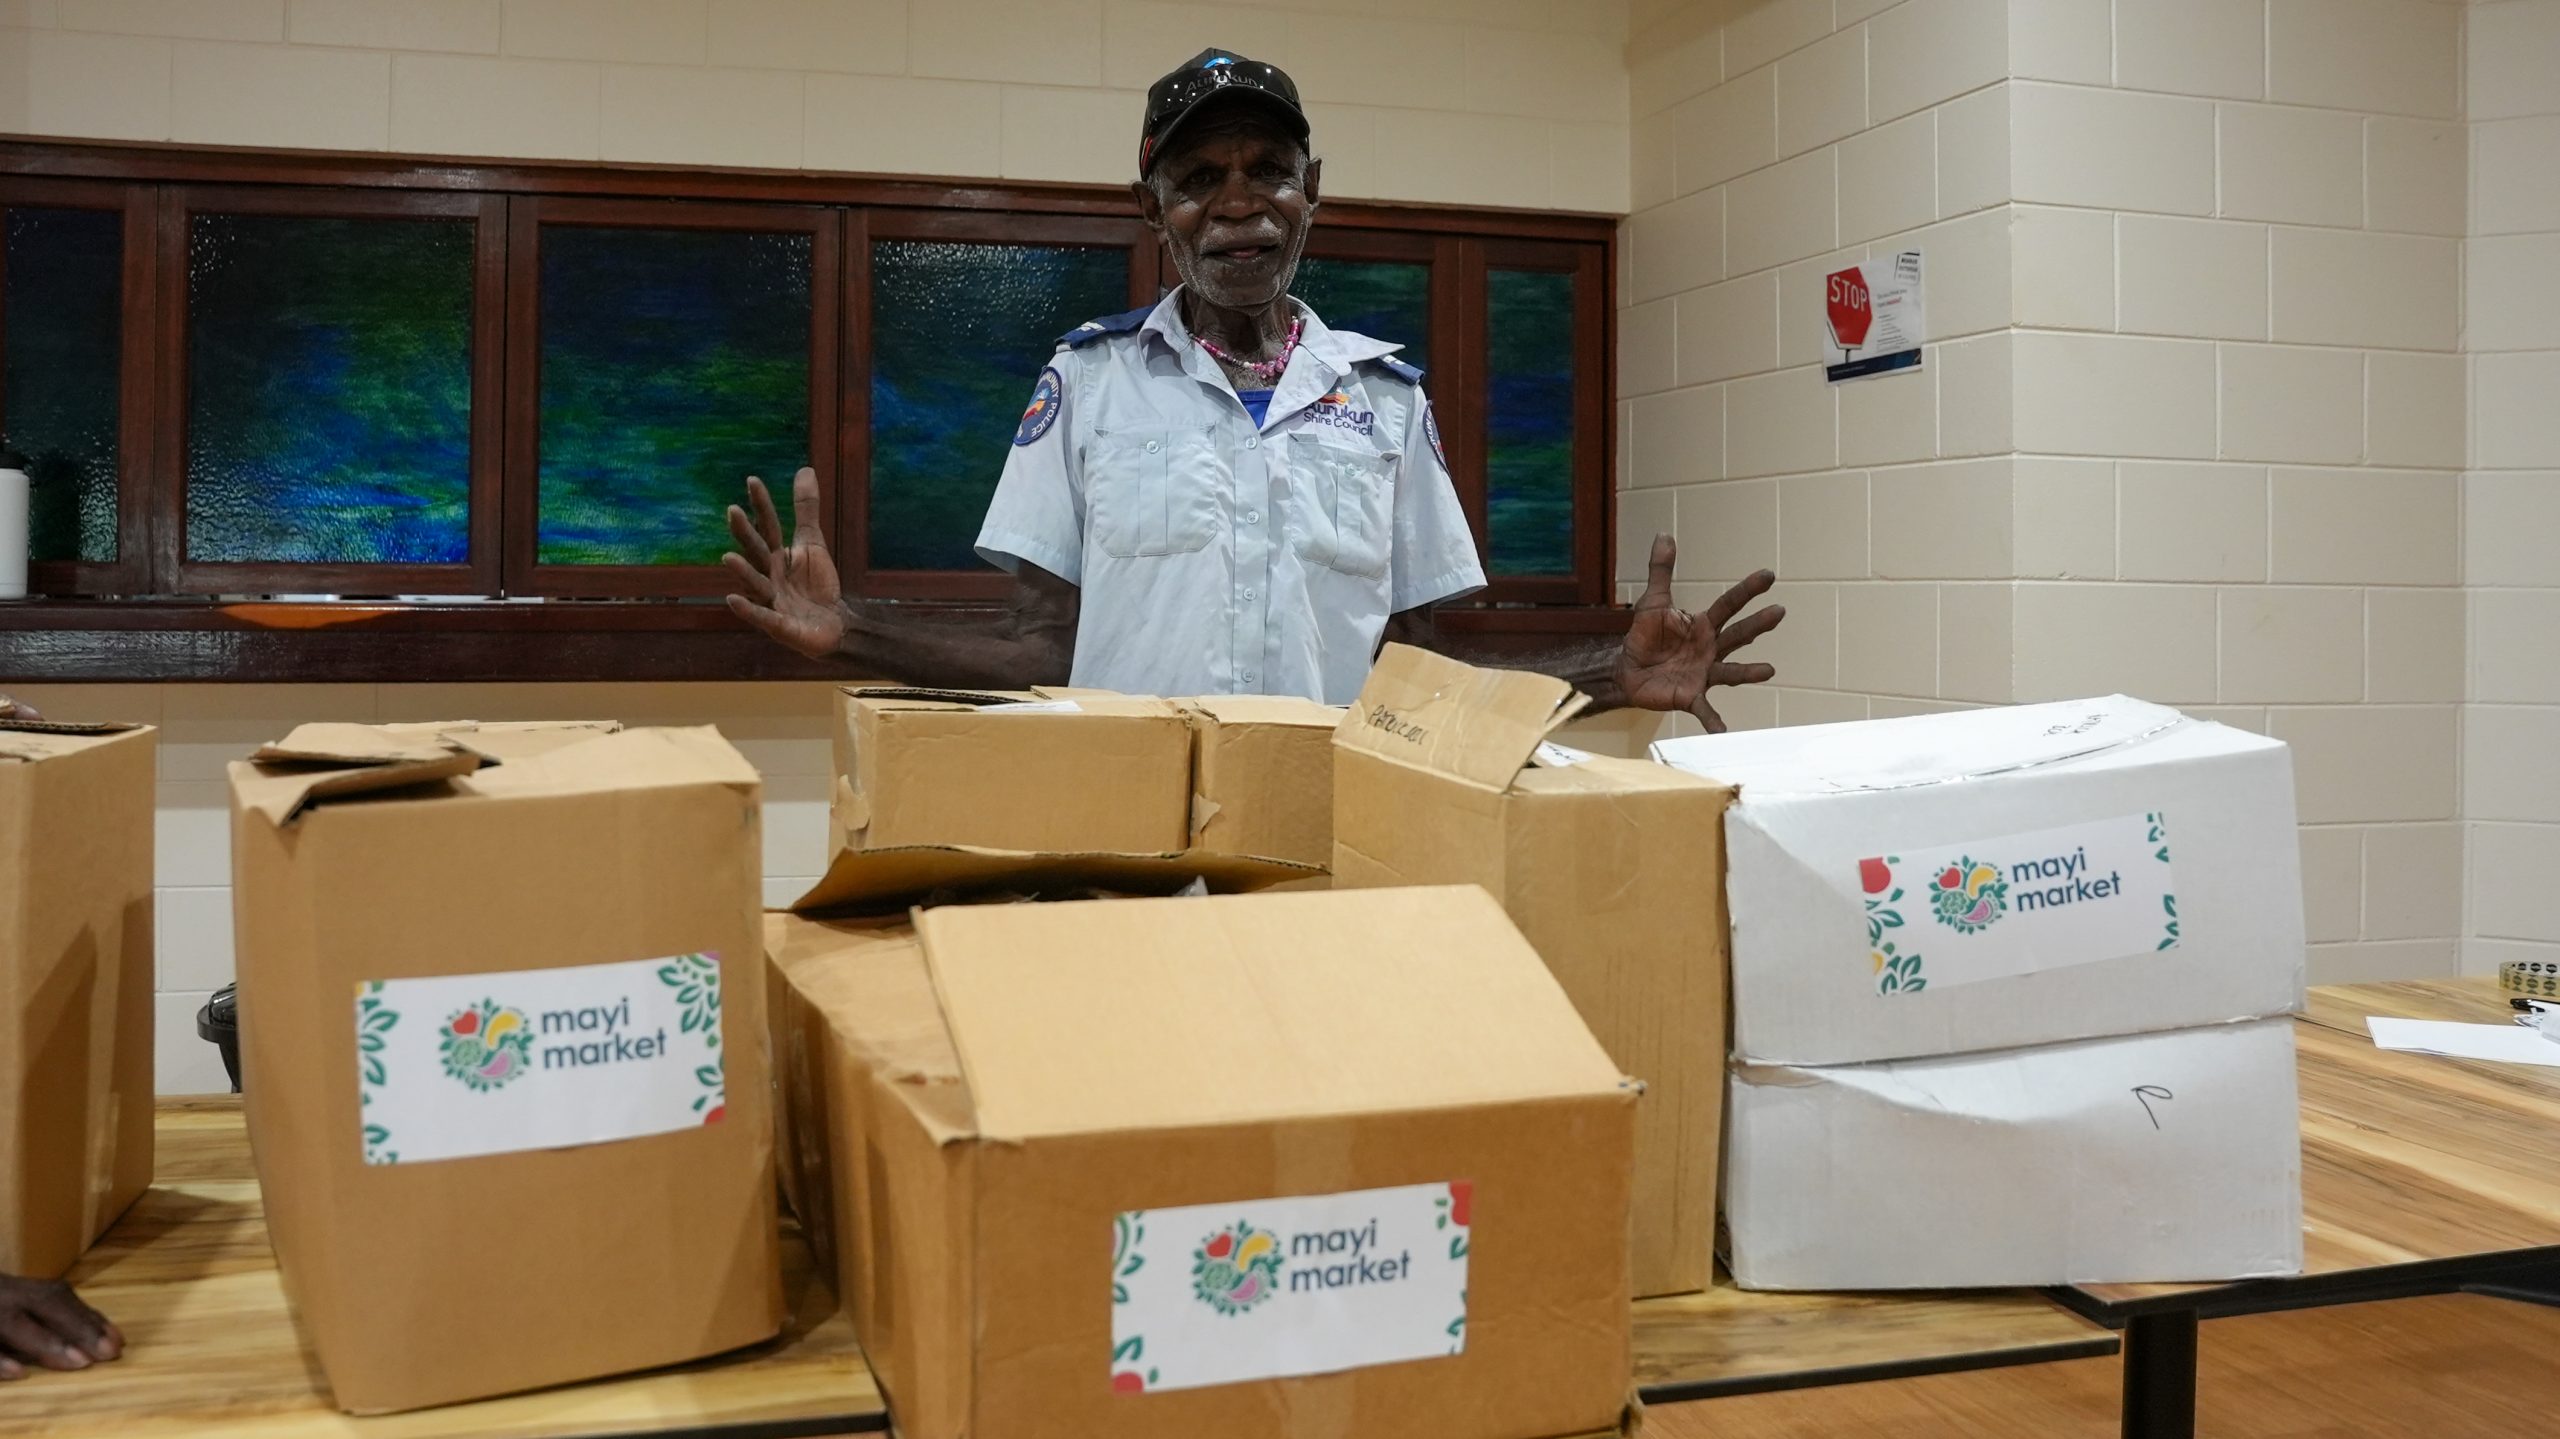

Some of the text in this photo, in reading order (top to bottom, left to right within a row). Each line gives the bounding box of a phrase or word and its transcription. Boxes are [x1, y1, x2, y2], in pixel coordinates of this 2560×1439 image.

[1831, 275, 1868, 312] STOP
[1031, 402, 1057, 438] POLICE
[1303, 412, 1374, 437] Shire Council
[2012, 846, 2086, 882] mayi
[2016, 870, 2121, 912] market
[540, 998, 629, 1035] mayi
[543, 1029, 666, 1069] market
[1291, 1218, 1378, 1257] mayi
[1290, 1250, 1410, 1293] market
